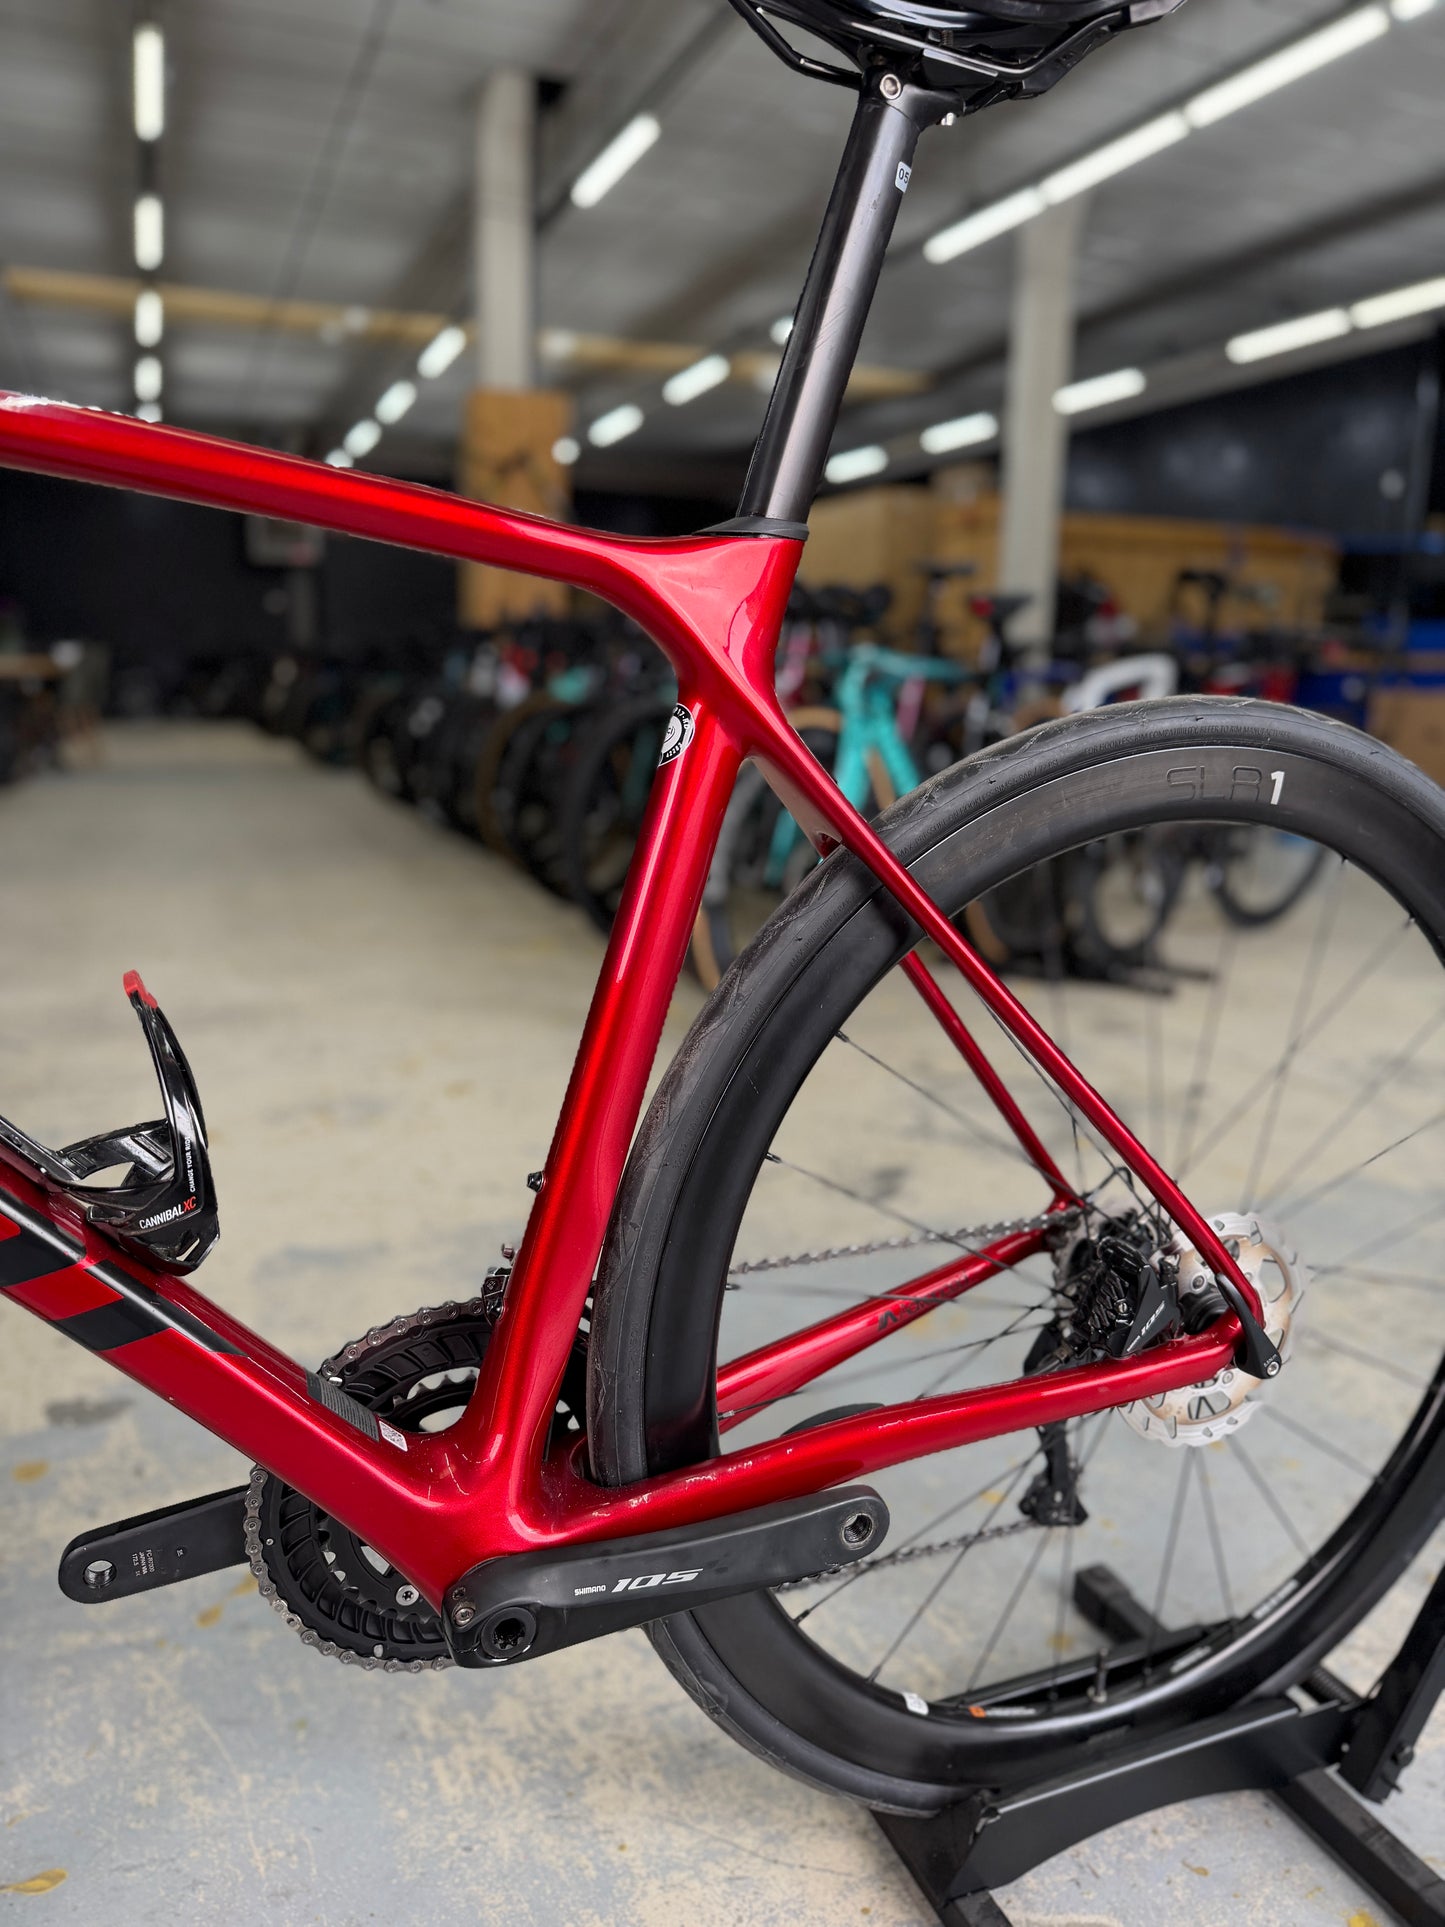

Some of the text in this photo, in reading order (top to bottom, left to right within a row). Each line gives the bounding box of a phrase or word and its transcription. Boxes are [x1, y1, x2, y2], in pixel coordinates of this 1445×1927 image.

[898, 168, 910, 184] 05
[574, 1568, 704, 1596] SHIMANO 105
